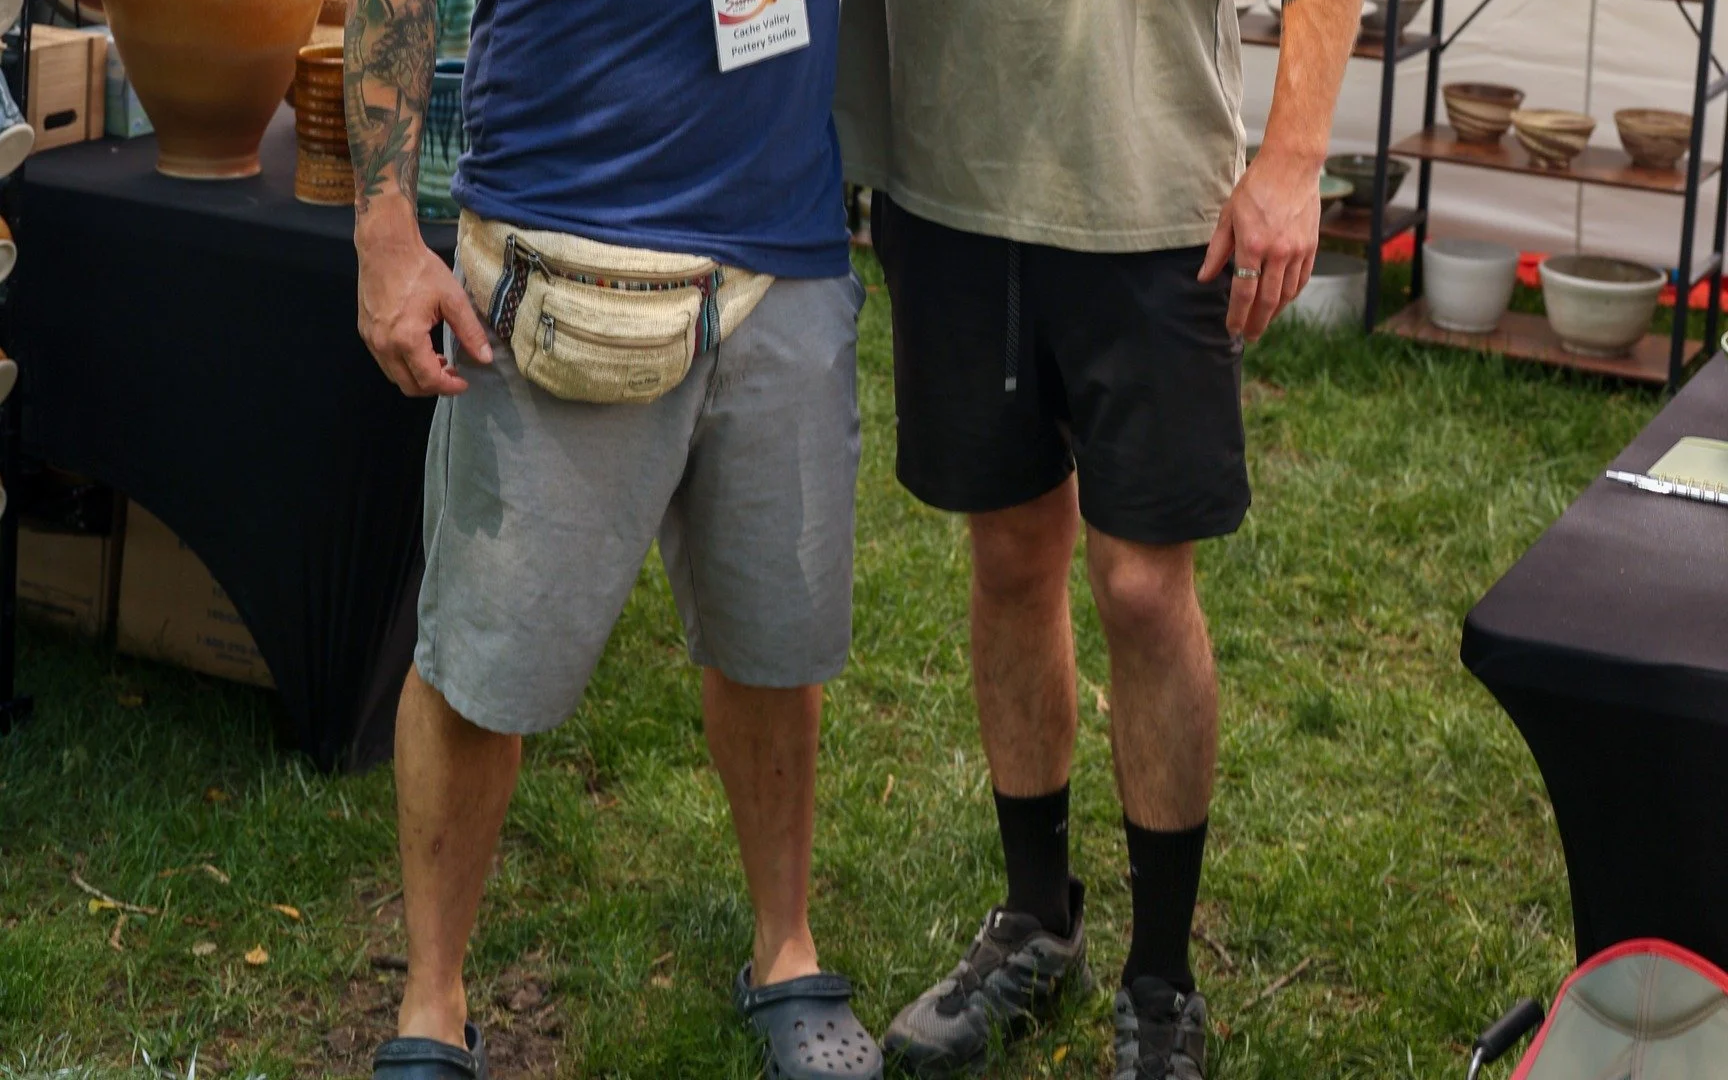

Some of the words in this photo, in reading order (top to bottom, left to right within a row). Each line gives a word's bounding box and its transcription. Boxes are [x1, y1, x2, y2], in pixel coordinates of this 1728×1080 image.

[733, 24, 761, 40] Cache
[762, 13, 790, 29] Valley
[731, 40, 766, 58] Pottery
[767, 27, 797, 44] Studio
